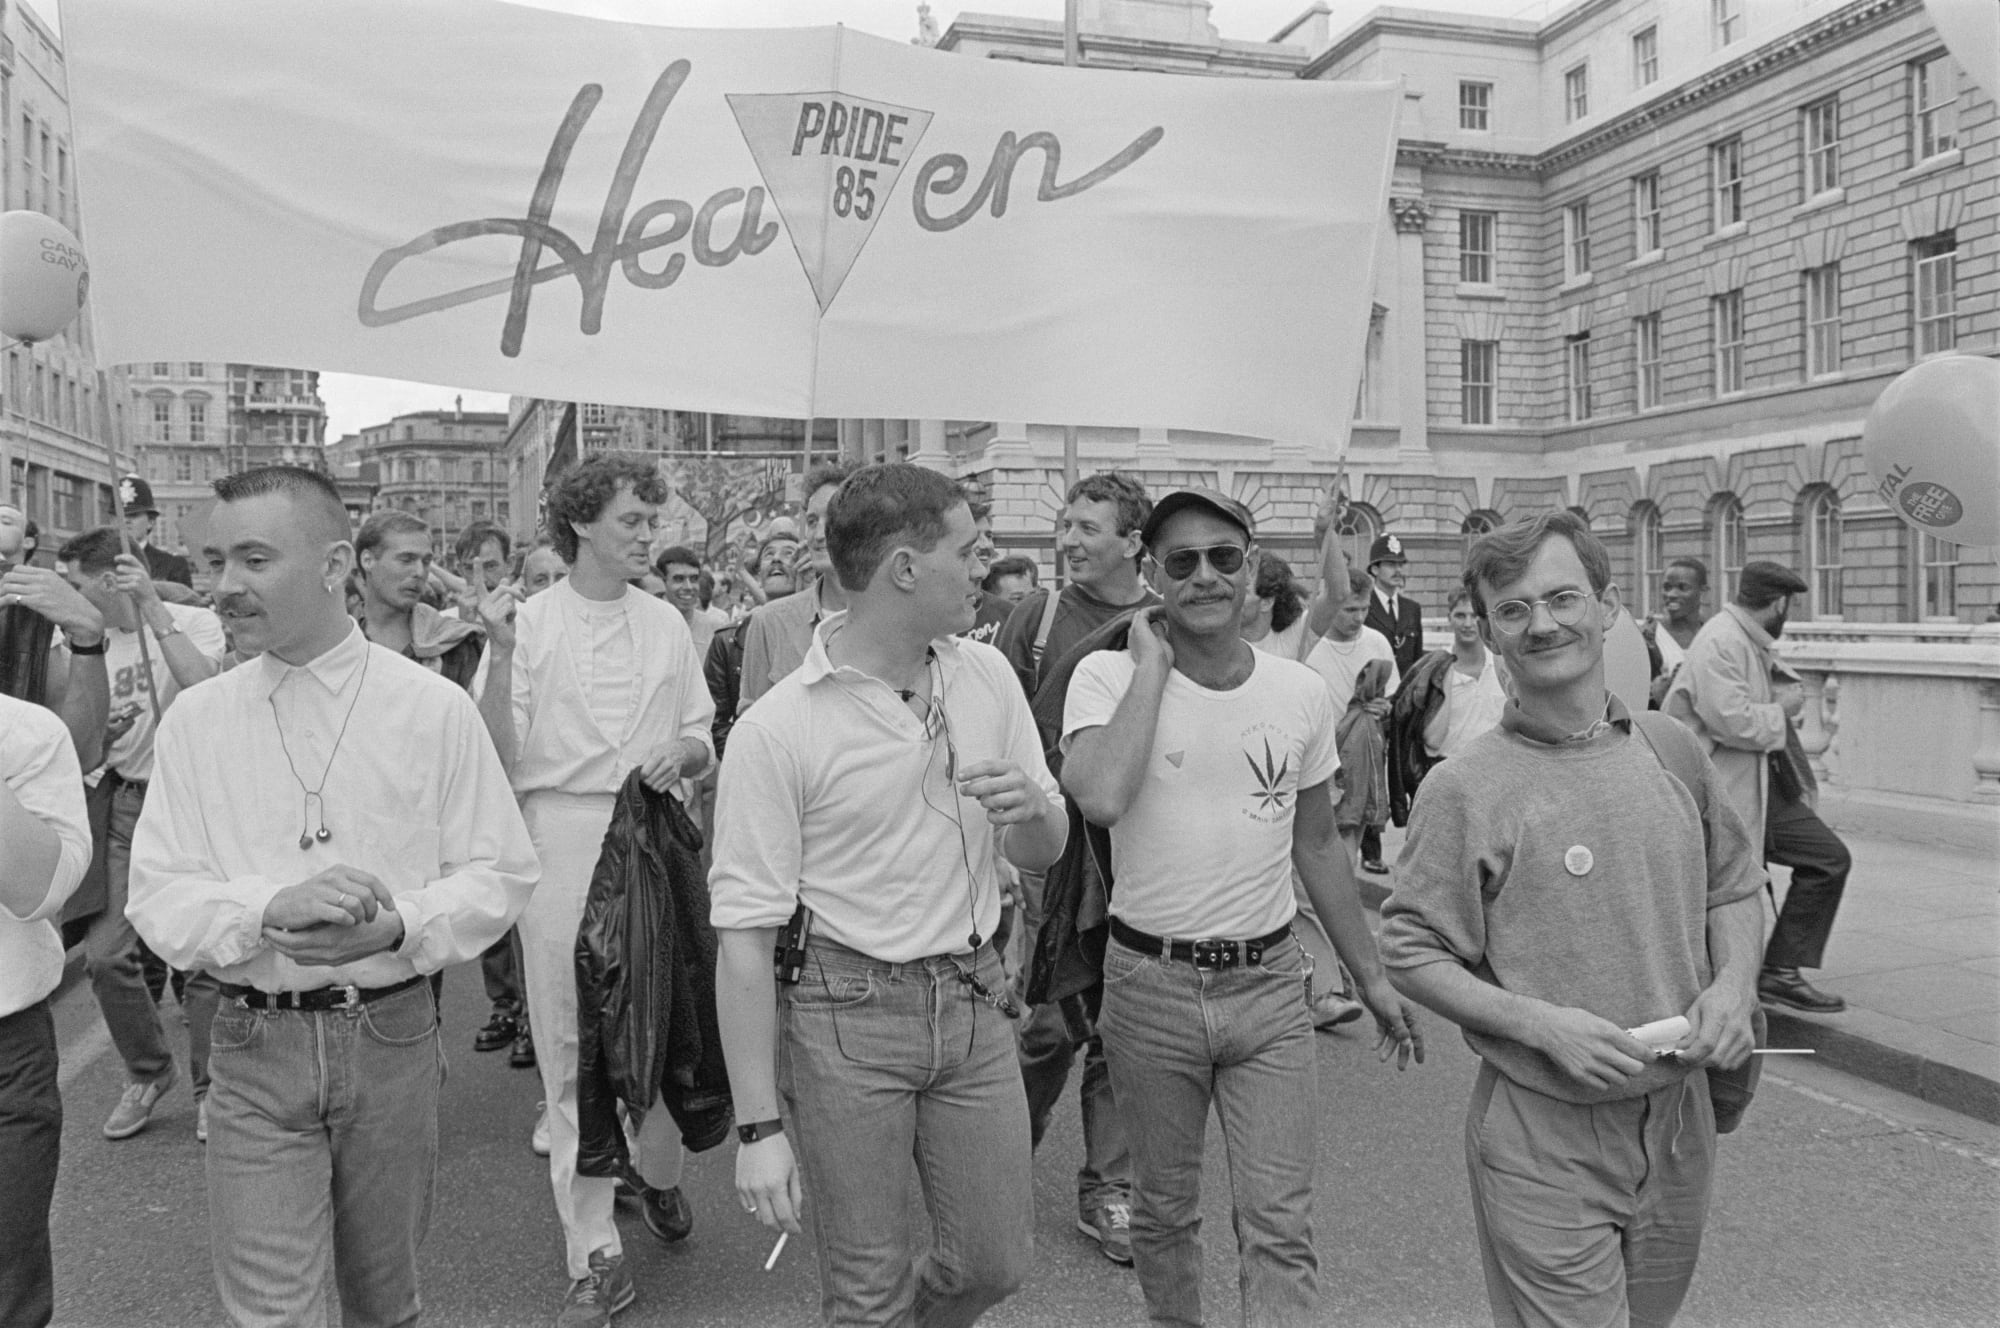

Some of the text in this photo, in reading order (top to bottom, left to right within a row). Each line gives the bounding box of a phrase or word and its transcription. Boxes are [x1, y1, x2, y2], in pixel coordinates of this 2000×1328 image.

[791, 101, 909, 167] PRIDE
[833, 165, 878, 221] 85
[41, 250, 78, 272] GAY
[1911, 486, 1949, 523] FREE
